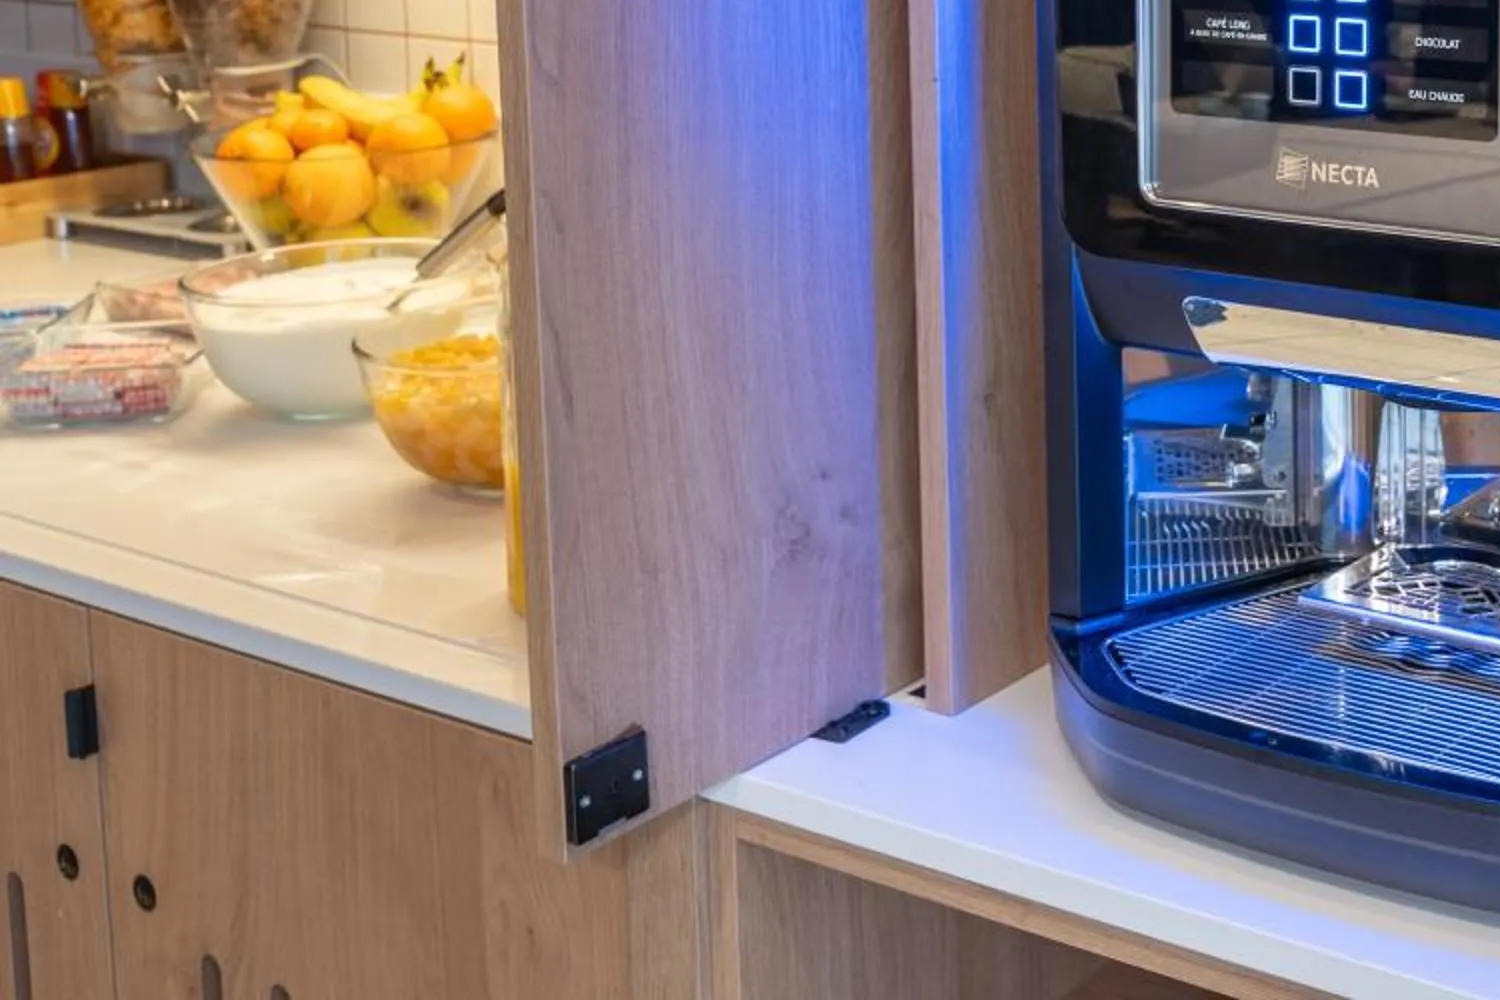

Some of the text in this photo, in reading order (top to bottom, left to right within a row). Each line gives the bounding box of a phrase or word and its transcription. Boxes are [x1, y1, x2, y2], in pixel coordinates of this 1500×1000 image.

[1415, 36, 1461, 50] CHOCOLAT
[1408, 89, 1465, 103] EAU CHAUDE
[1310, 160, 1380, 189] NECTA
